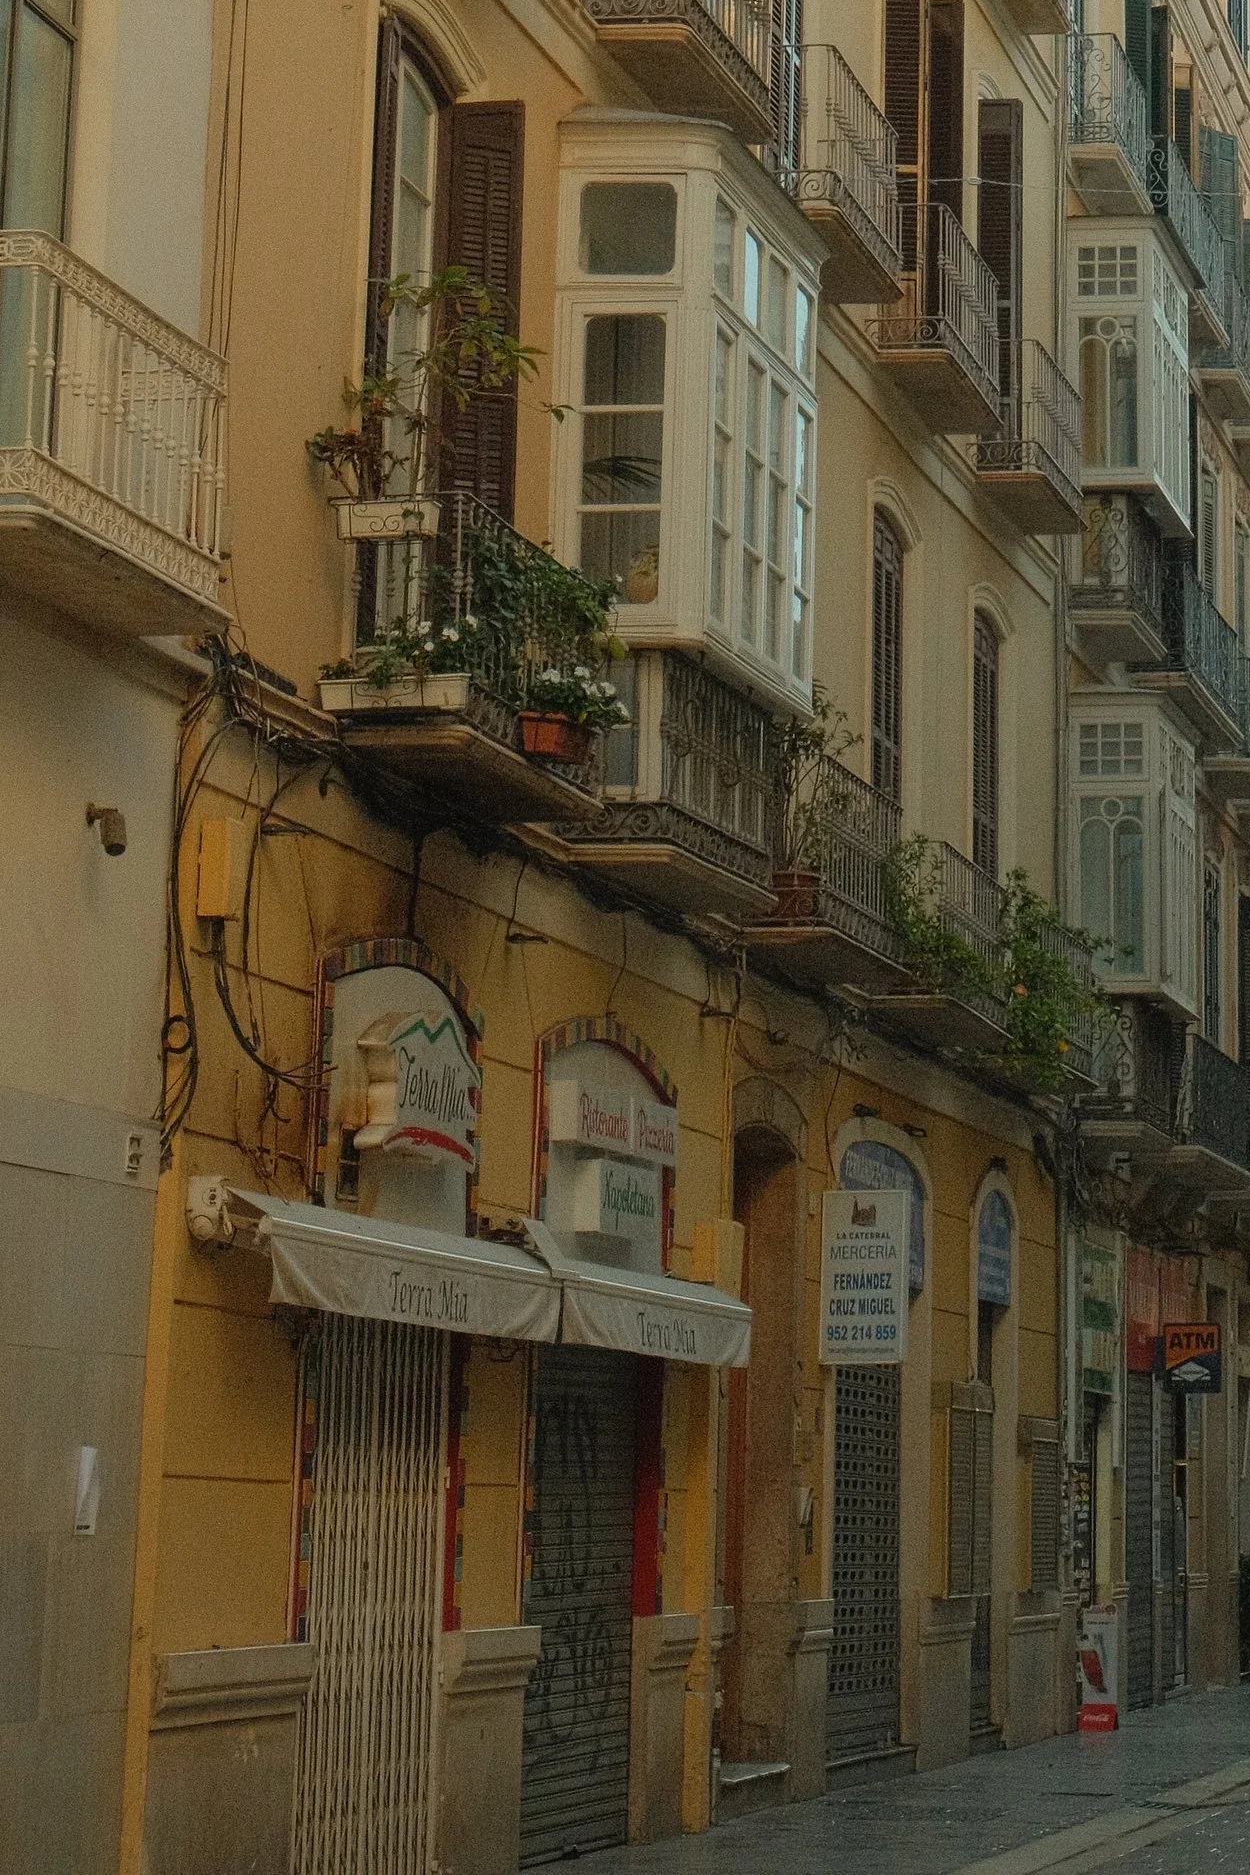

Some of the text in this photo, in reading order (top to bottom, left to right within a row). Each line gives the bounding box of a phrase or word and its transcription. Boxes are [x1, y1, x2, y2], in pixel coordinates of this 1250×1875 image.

[399, 1046, 439, 1114] Terra
[580, 1091, 628, 1142] Ristorante
[637, 1107, 674, 1156] Pizzeria
[836, 1232, 891, 1240] LA CATEDRAL
[830, 1244, 897, 1260] MERCERÍA
[833, 1269, 892, 1291] FERNÁNDEZ
[388, 1271, 468, 1323] Terra Mia
[829, 1298, 896, 1316] CRUZ MIGUEL
[637, 1311, 697, 1355] Terra Mia
[827, 1325, 897, 1341] 952 214 859
[1170, 1331, 1215, 1350] ATM
